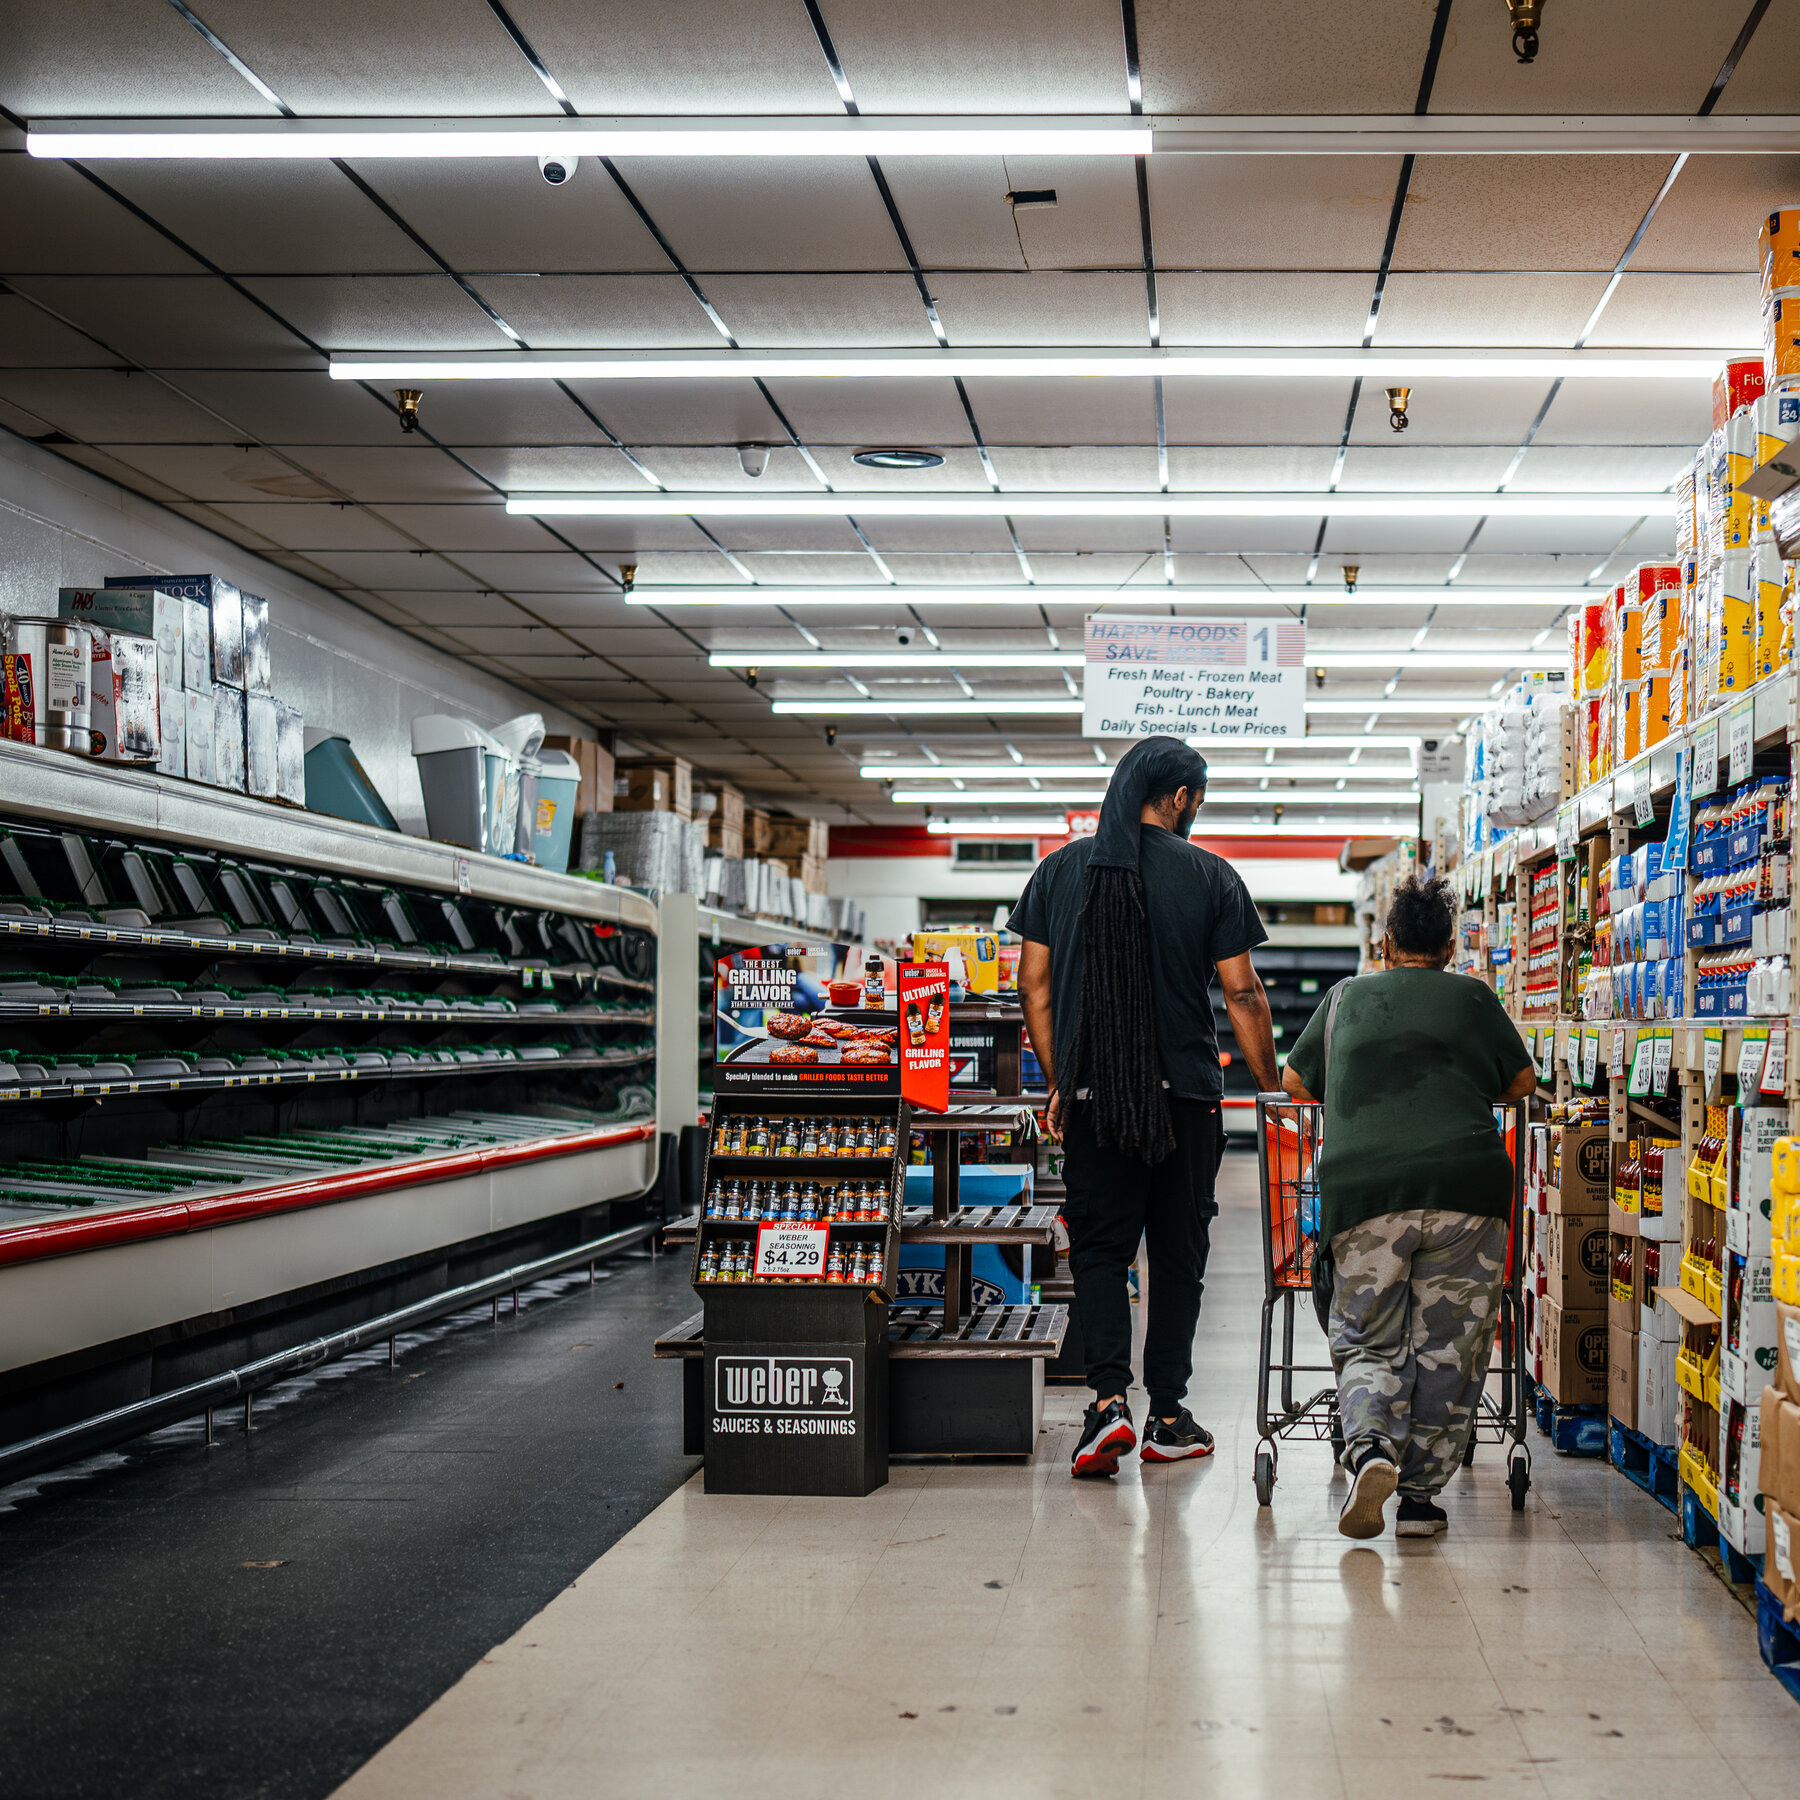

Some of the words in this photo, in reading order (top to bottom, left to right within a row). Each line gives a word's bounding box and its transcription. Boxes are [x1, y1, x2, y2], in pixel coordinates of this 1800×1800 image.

[1744, 372, 1764, 387] Fio
[1781, 410, 1798, 420] 24
[1092, 624, 1163, 641] HAPPY
[1168, 626, 1240, 642] FOODS
[1253, 627, 1269, 661] 1
[1105, 644, 1158, 661] SAVE
[1165, 646, 1227, 663] MORE
[5, 655, 19, 693] Stock
[17, 667, 30, 684] 40
[1108, 668, 1147, 681] Fresh
[1151, 669, 1185, 682] Meat
[1198, 670, 1245, 683] Frozen
[1249, 671, 1283, 684] Meat
[22, 684, 30, 703] QUART
[1143, 686, 1193, 702] Poultry
[1206, 687, 1255, 703] Bakery
[11, 696, 23, 726] Pots
[1135, 703, 1164, 716] Fish
[1178, 704, 1221, 717] Lunch
[1225, 705, 1259, 718] Meat
[1100, 719, 1135, 734] Daily
[1139, 720, 1198, 735] Specials
[1211, 722, 1240, 735] Low
[1244, 722, 1288, 736] Prices
[1695, 761, 1713, 786] $6.49
[744, 960, 758, 969] THE
[761, 960, 780, 969] BEST
[728, 969, 797, 985] GRILLING
[734, 985, 791, 1001] FLAVOR
[902, 981, 947, 1002] ULTIMATE
[954, 1036, 985, 1047] SPONSORS
[905, 1048, 945, 1058] GRILLING
[909, 1059, 941, 1070] FLAVOR
[725, 1072, 751, 1082] Specially
[751, 1073, 774, 1081] blended
[775, 1073, 782, 1081] to
[782, 1073, 798, 1081] make
[799, 1073, 824, 1081] GRILLED
[825, 1073, 846, 1081] FOODS
[866, 1074, 889, 1082] BETTER
[1585, 1145, 1609, 1160] OPE
[1589, 1160, 1609, 1174] PI
[773, 1223, 816, 1231] SPECIAL!
[769, 1242, 816, 1250] SEASONING
[764, 1250, 820, 1266] $4.29
[1584, 1335, 1608, 1349] OPE
[1588, 1349, 1608, 1363] PI
[713, 1418, 760, 1433] SAUCES
[764, 1418, 773, 1434] &
[777, 1419, 856, 1435] SEASONINGS
